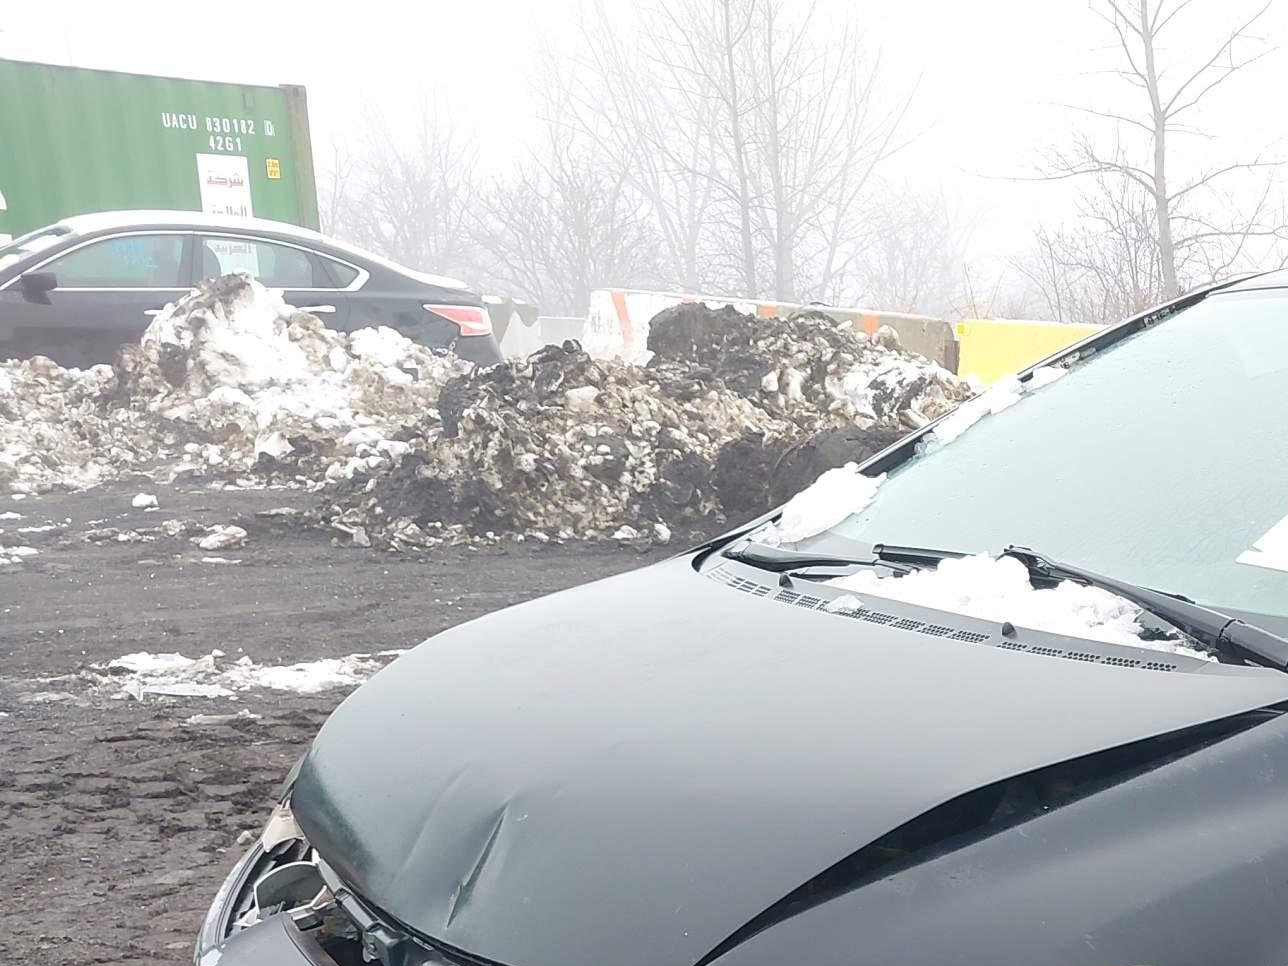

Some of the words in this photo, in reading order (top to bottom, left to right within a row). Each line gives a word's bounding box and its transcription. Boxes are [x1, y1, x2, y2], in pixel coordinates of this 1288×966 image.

[161, 113, 197, 129] UACU
[206, 117, 255, 134] 830182
[209, 136, 241, 151] 42G1
